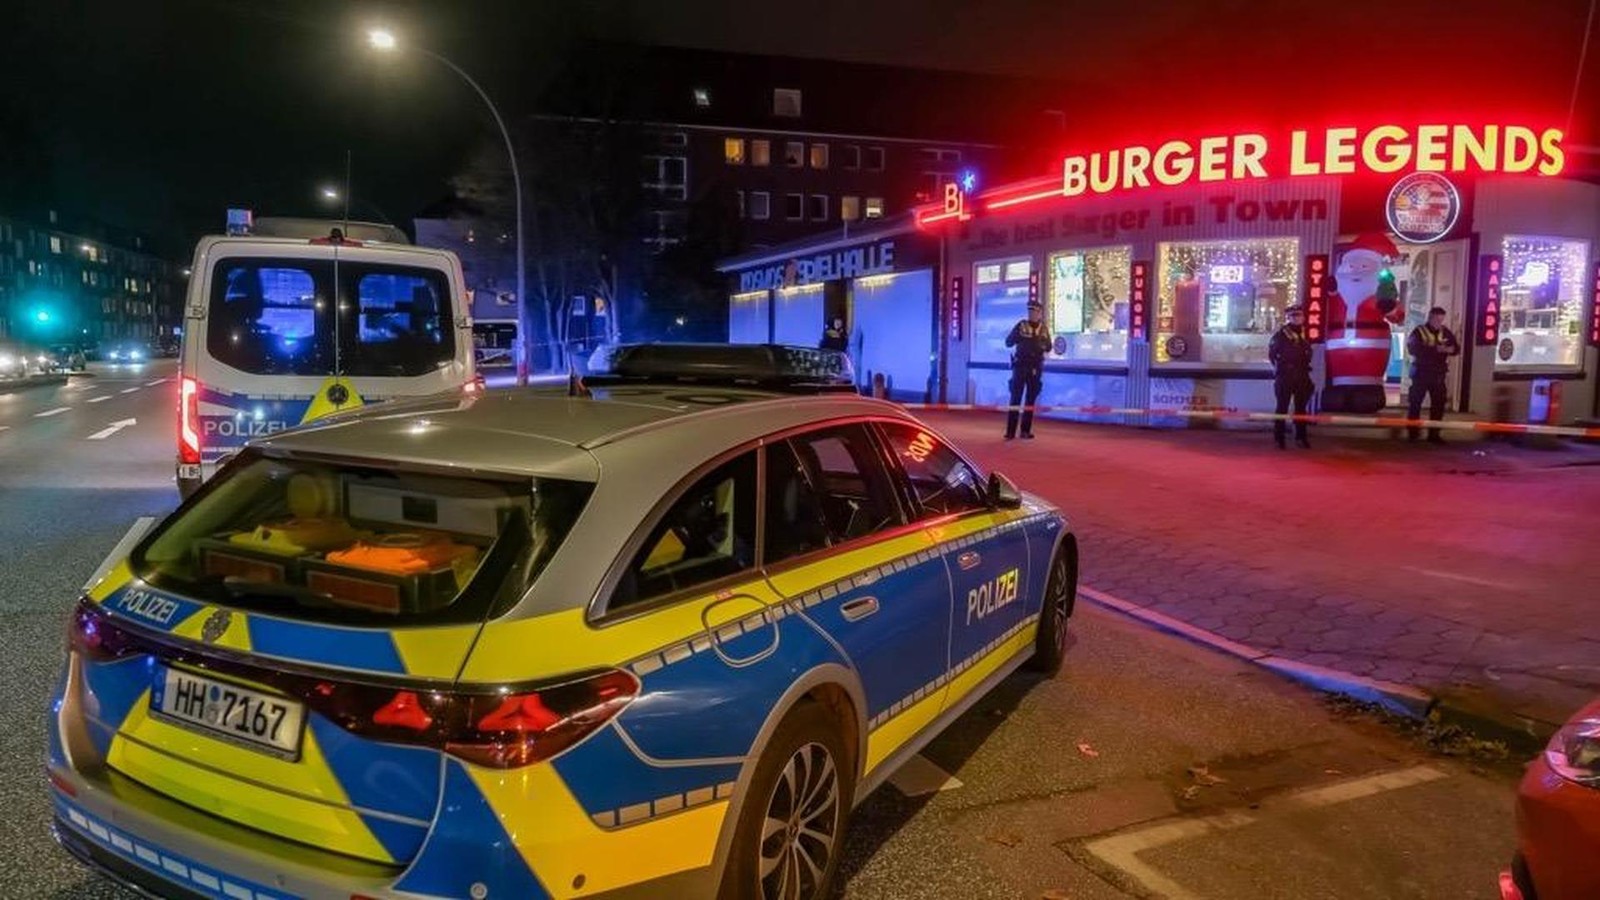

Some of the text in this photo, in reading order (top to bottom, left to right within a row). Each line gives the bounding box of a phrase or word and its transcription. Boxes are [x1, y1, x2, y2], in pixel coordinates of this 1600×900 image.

[1063, 125, 1565, 197] BURGER LEGENDS
[944, 183, 971, 221] BL
[1162, 201, 1195, 228] in
[1208, 196, 1327, 224] Town
[797, 242, 895, 285] SPIELHALLE
[1485, 260, 1499, 340] SALADS
[119, 589, 179, 624] POLIZEI
[966, 568, 1018, 626] POLIZEI
[173, 677, 288, 741] HH 7167
